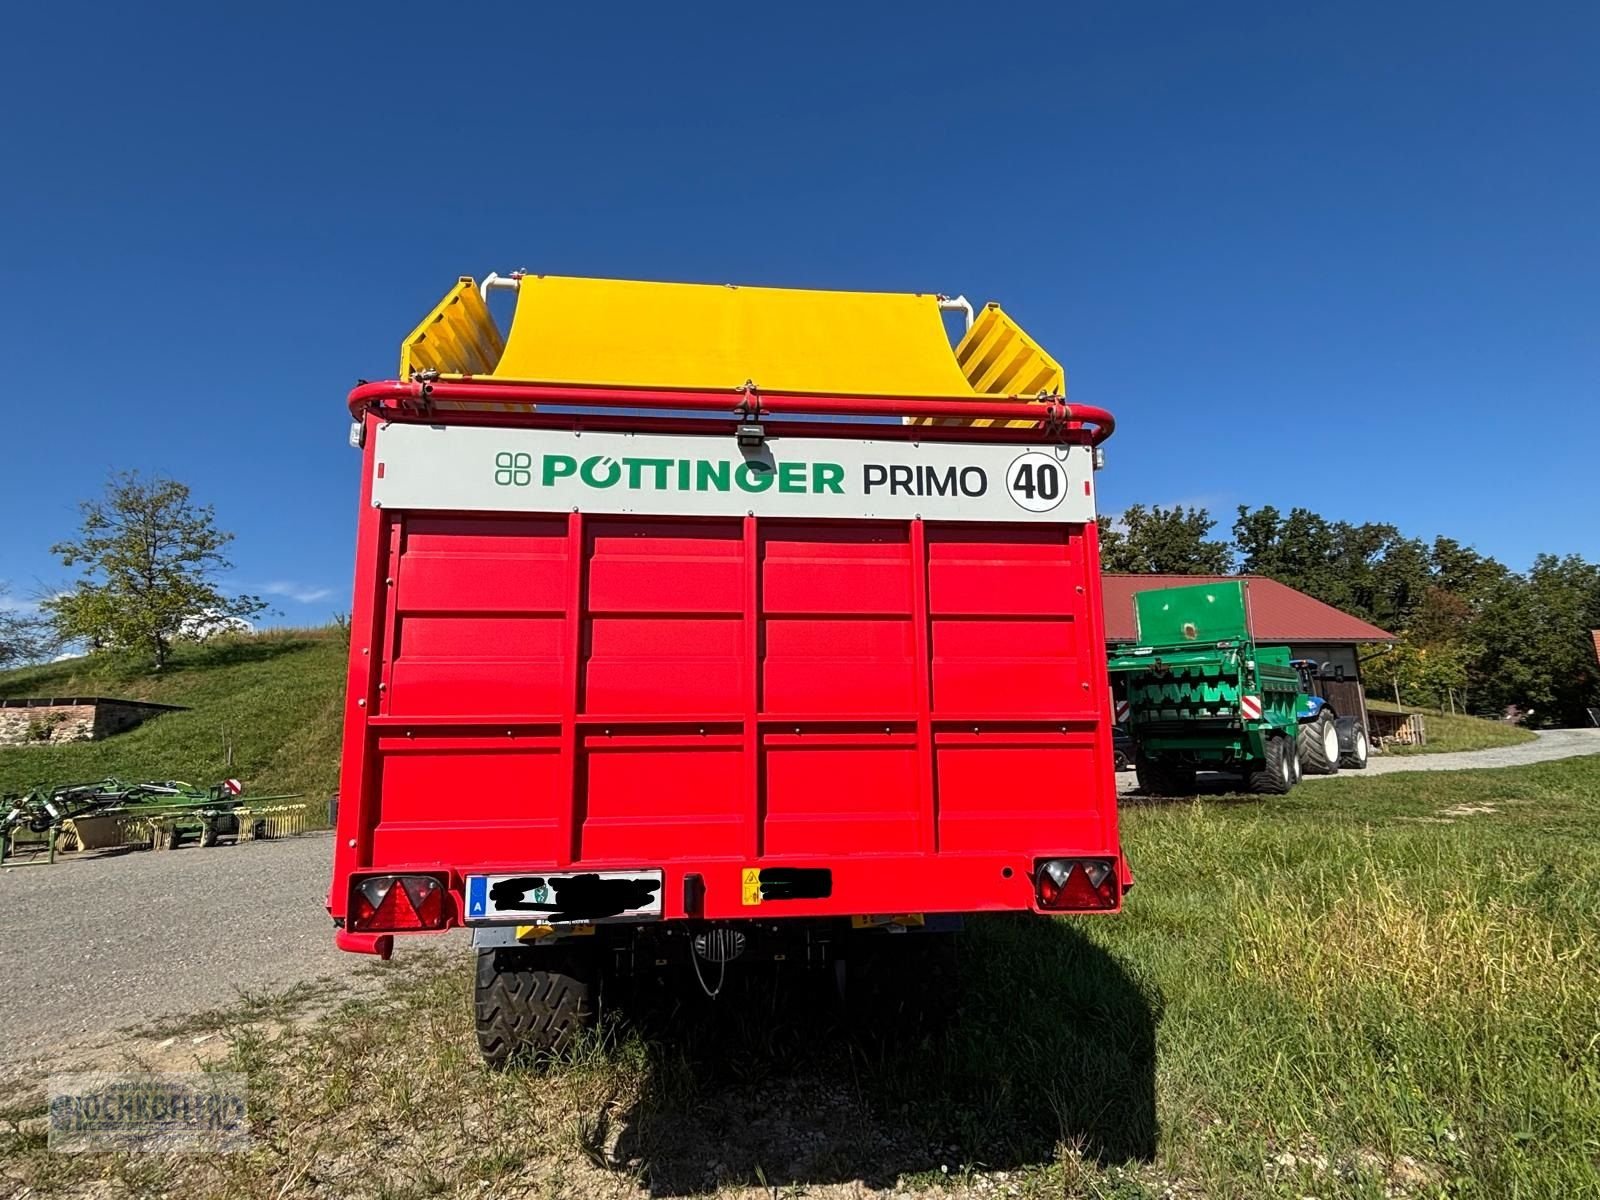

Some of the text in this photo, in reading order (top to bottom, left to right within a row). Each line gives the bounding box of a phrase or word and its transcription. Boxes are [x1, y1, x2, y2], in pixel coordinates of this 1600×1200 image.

[542, 454, 988, 498] PÖTTINGER PRIMO
[1013, 463, 1058, 501] 40
[473, 902, 482, 912] A
